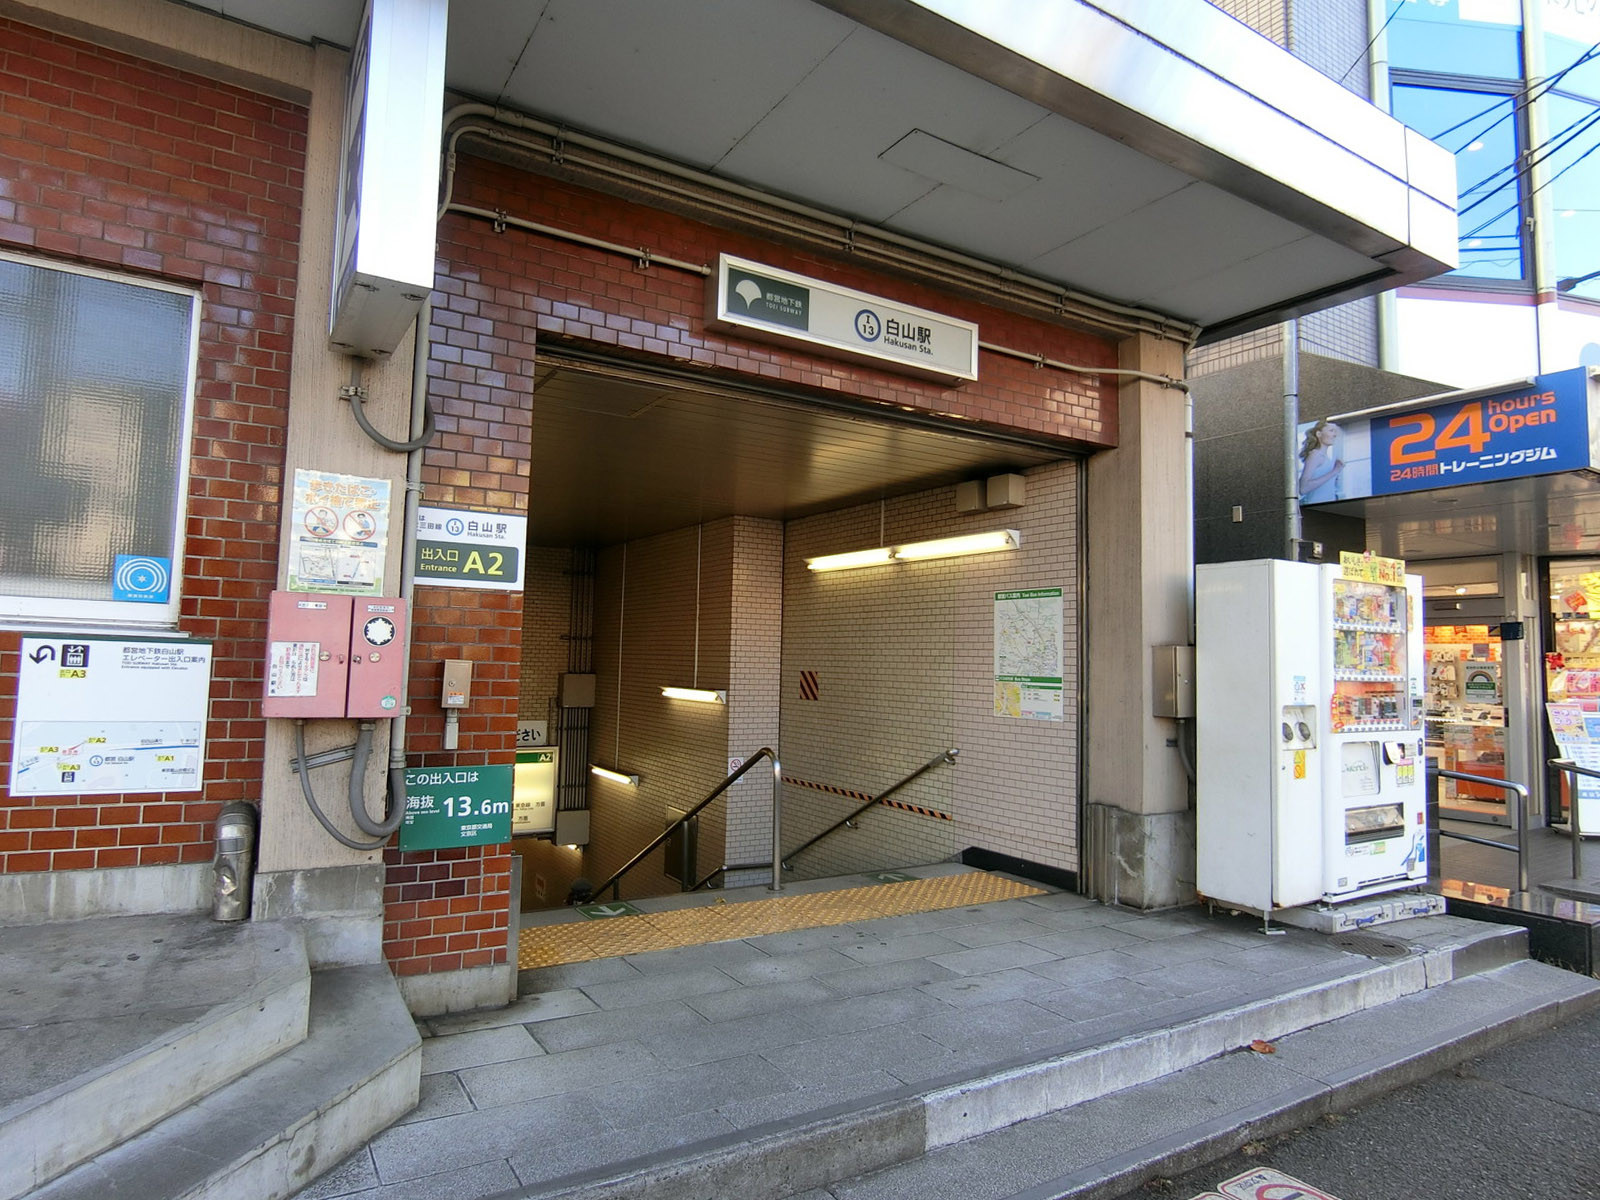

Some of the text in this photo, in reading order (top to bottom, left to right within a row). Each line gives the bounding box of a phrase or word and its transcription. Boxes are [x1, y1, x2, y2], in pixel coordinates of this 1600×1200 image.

[766, 292, 802, 308] 都営地下鉄
[766, 302, 802, 316] TOEI SUBWAY
[862, 324, 874, 336] 13
[886, 319, 932, 345] 白山駅
[883, 335, 934, 355] Hakusan Sta.
[1489, 409, 1557, 433] Open
[1389, 391, 1556, 466] 24 hours
[416, 521, 442, 530] 三田線
[468, 521, 507, 534] 白山駅
[467, 531, 493, 539] Hakusan
[421, 547, 459, 562] 出入口
[420, 563, 457, 573] Entrance
[462, 550, 504, 576] A2
[123, 646, 185, 655] 都営地下鉄白山駅
[122, 654, 206, 664] エレベーター出入口案内
[70, 670, 86, 678] A3
[540, 753, 551, 761] A2
[405, 771, 479, 786] この出入口は
[406, 795, 509, 818] 海抜 13.6m
